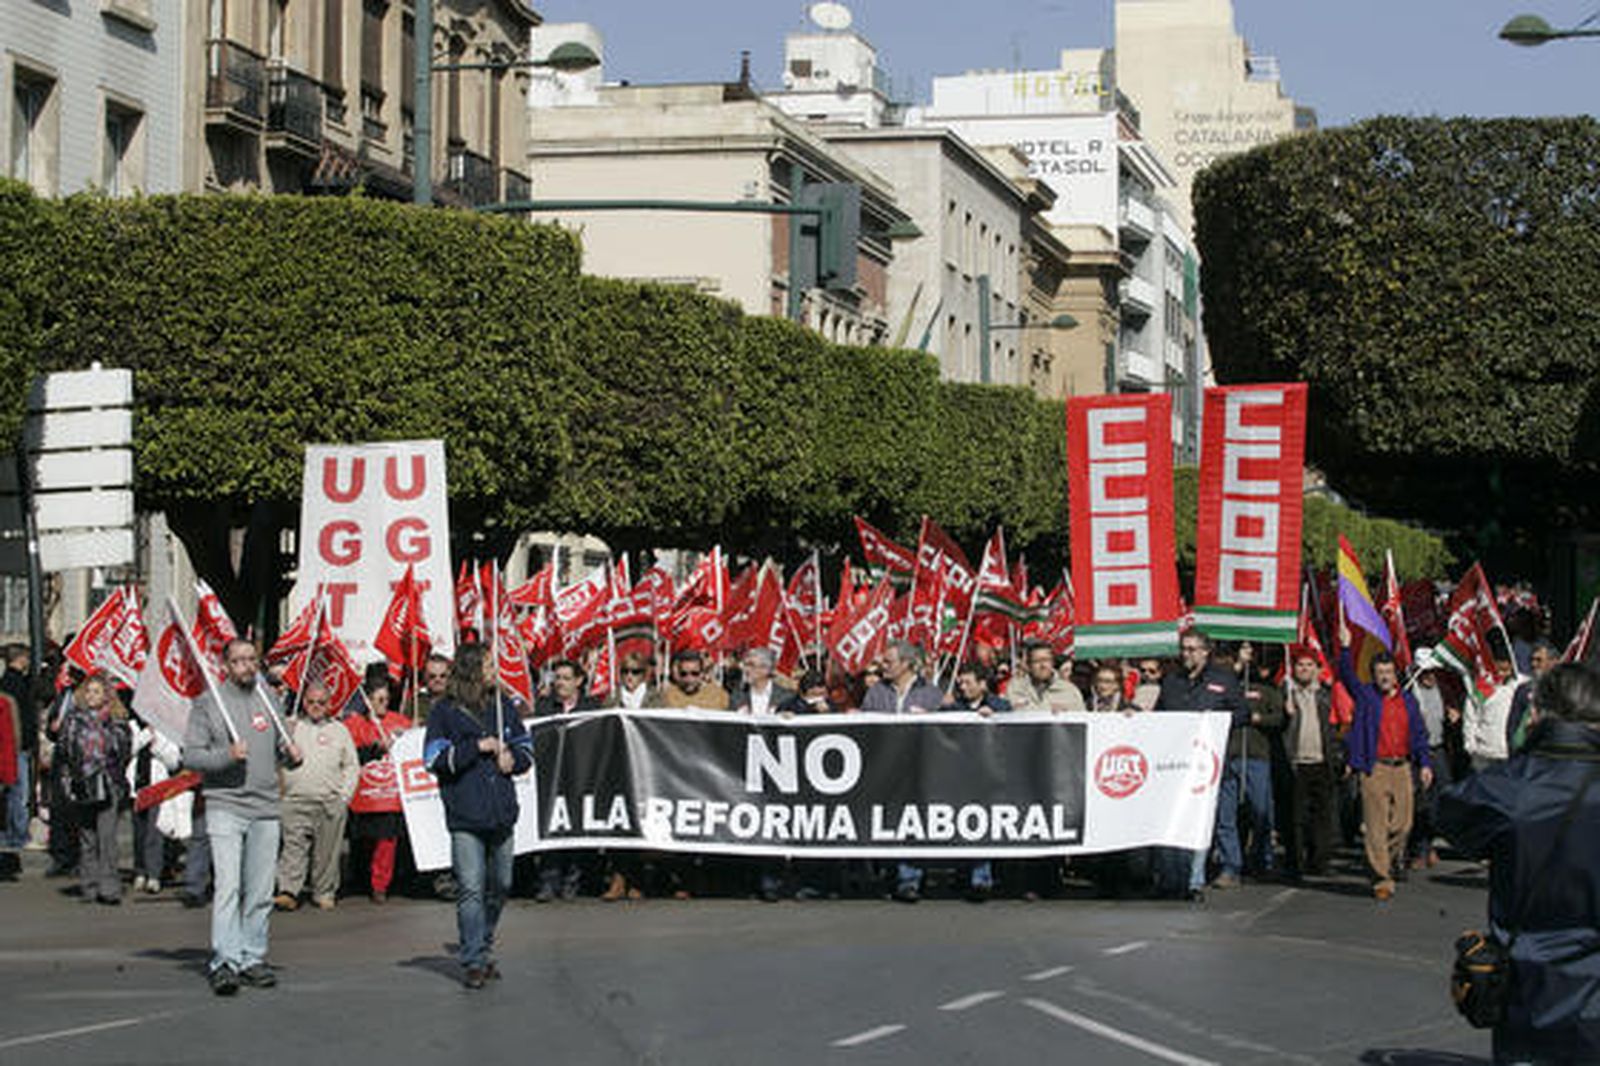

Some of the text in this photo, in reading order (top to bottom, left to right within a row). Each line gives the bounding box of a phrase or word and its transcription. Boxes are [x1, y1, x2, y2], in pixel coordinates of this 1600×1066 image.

[1013, 73, 1110, 97] HOTEL
[1087, 407, 1152, 621] CCOO
[1218, 391, 1284, 607] CCOO
[318, 457, 366, 628] UGT
[745, 734, 862, 795] NO
[1100, 754, 1142, 777] UGT
[550, 795, 1077, 843] A LA REFORMA LABORAL
